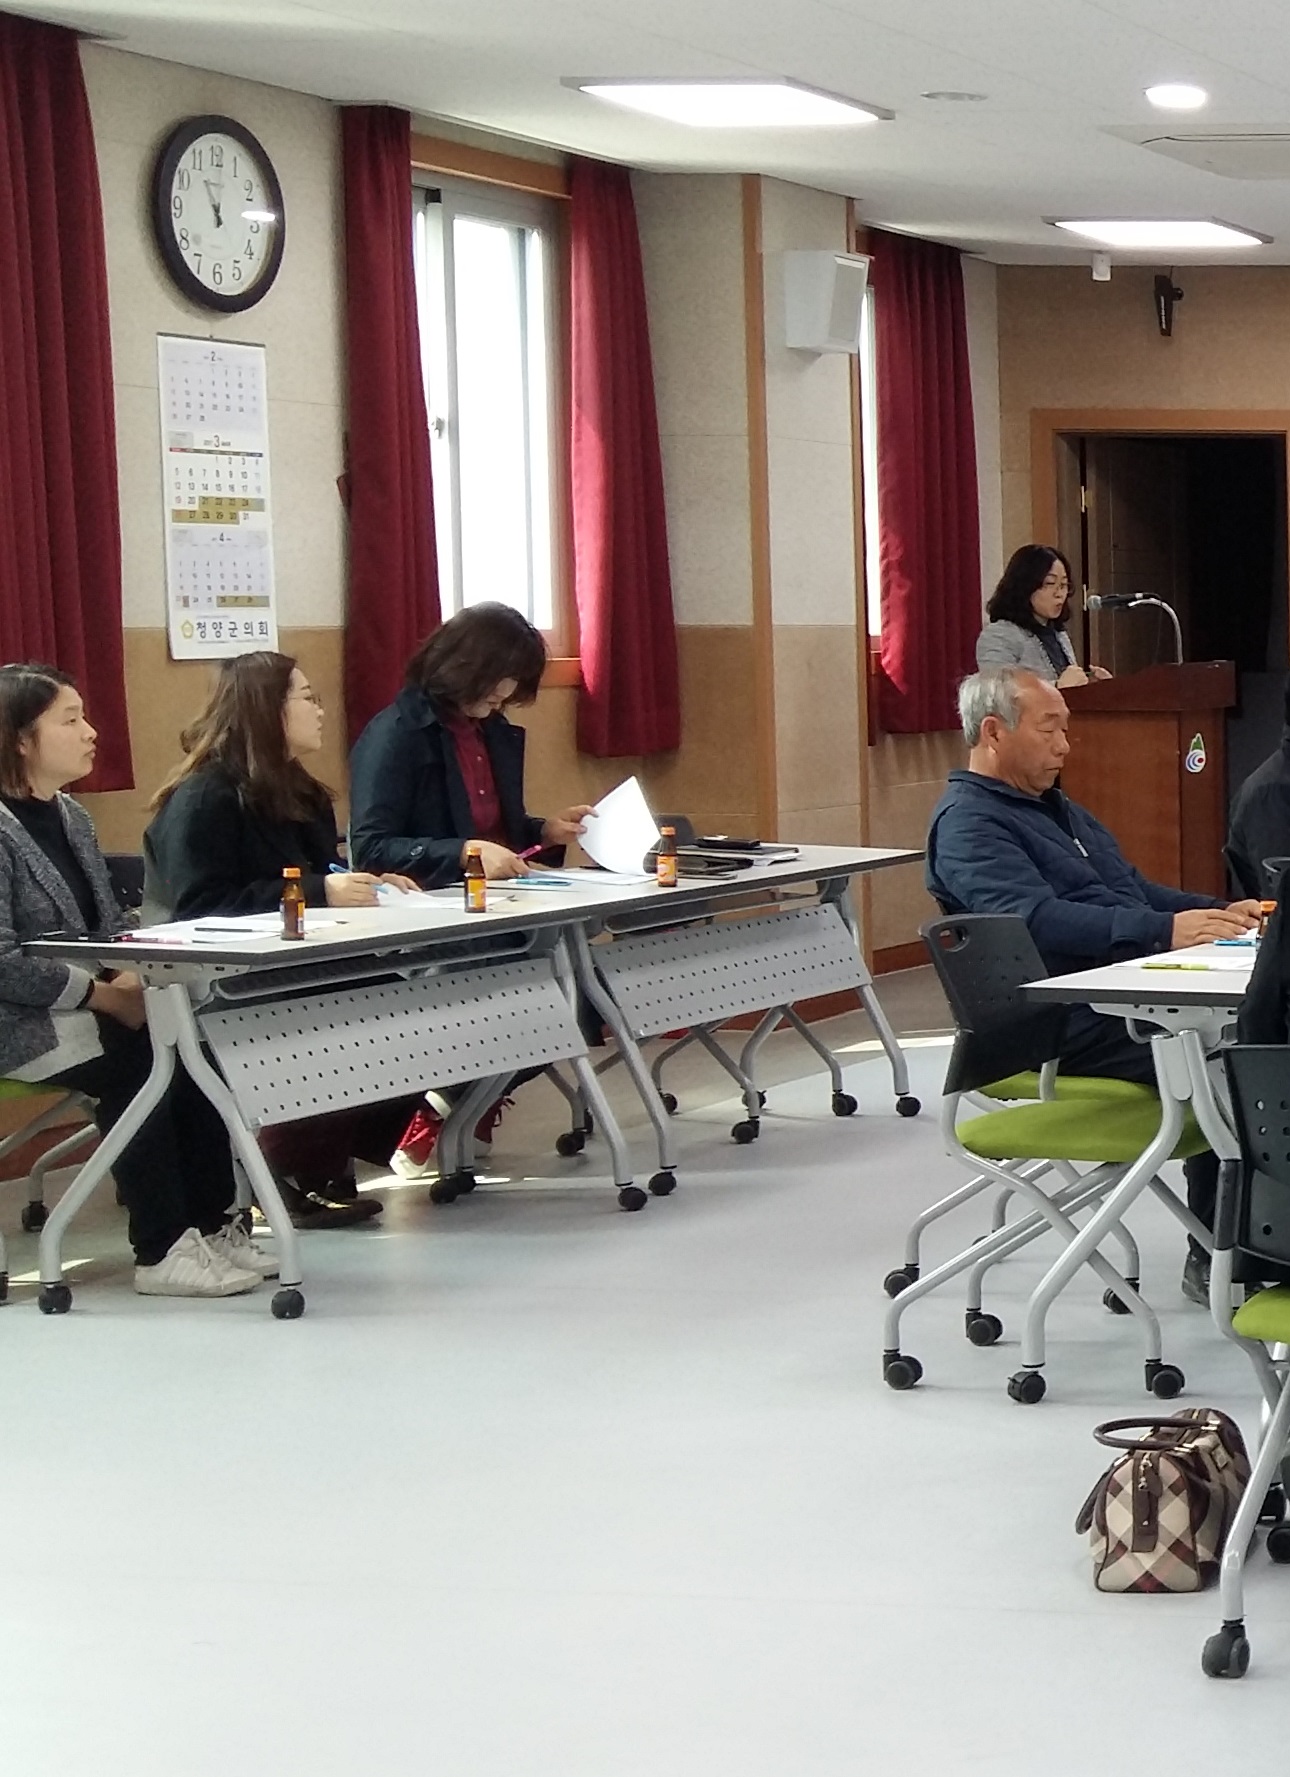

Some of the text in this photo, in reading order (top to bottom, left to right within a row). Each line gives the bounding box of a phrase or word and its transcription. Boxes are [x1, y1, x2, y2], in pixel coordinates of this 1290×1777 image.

[192, 149, 202, 171] 11
[210, 145, 224, 167] 12
[233, 156, 238, 178] 1
[177, 169, 190, 191] 10
[244, 180, 253, 202] 2
[173, 196, 182, 218] 9
[179, 228, 190, 250] 8
[244, 239, 254, 260] 4
[194, 253, 202, 275] 7
[212, 263, 222, 285] 6
[232, 260, 242, 281] 5
[213, 434, 220, 448] 3
[197, 621, 268, 639] 청양군의회
